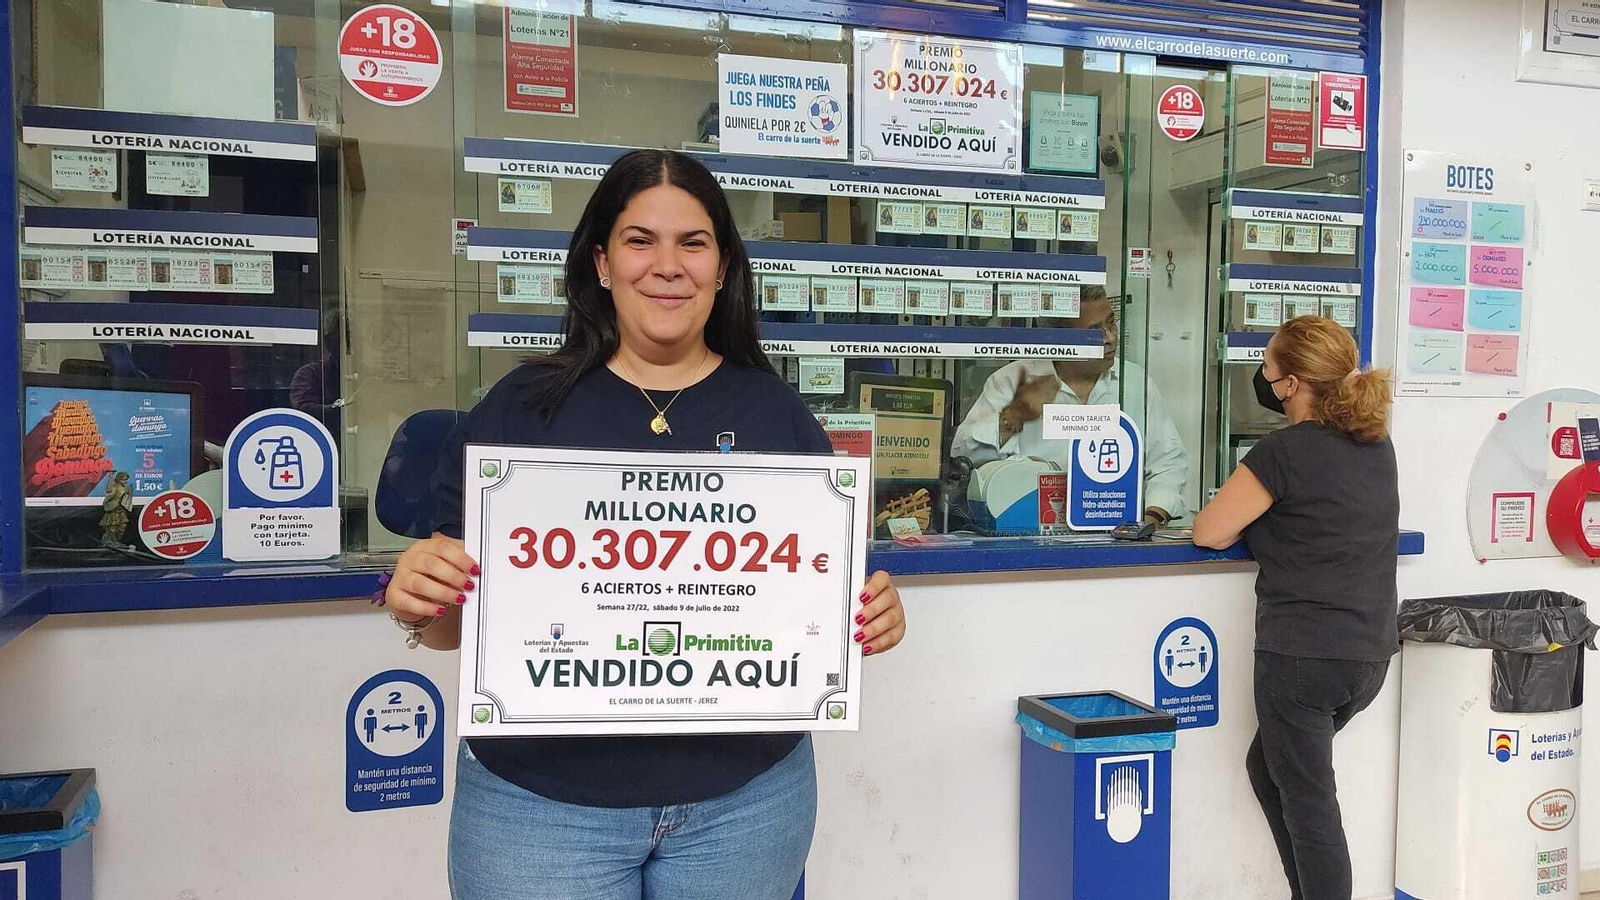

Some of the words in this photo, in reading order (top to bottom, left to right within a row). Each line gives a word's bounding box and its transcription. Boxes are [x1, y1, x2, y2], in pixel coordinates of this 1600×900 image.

[361, 16, 416, 49] +18
[549, 29, 569, 37] Nº21
[919, 45, 963, 58] PREMIO
[1096, 33, 1289, 65] www.elcarrodelasuerte.com
[511, 52, 534, 61] Alarma
[535, 55, 570, 65] Conectada
[531, 62, 564, 71] Seguridad
[904, 58, 977, 74] MILLONARIO
[725, 71, 756, 86] JUEGA
[759, 74, 802, 89] NUESTRA
[805, 76, 830, 91] PEÑA
[872, 69, 996, 99] 30.307.024
[1000, 90, 1007, 100] €
[729, 90, 752, 106] LOS
[756, 92, 796, 109] FINDES
[909, 98, 937, 106] ACIERTOS
[1168, 91, 1193, 109] +18
[725, 116, 767, 130] QUINIELA
[771, 119, 790, 131] POR
[794, 120, 806, 132] 2€
[918, 123, 928, 132] La
[947, 126, 984, 135] Primitiva
[92, 134, 163, 148] LOTERÍA
[169, 140, 253, 153] NACIONAL
[784, 134, 791, 142] de
[801, 136, 820, 144] suerte
[881, 132, 951, 149] VENDIDO
[957, 136, 996, 153] AQUÍ
[500, 162, 559, 174] LOTERÍA
[730, 176, 794, 189] NACIONAL
[1446, 164, 1493, 190] BOTES
[830, 182, 880, 194] LOTERÍA
[883, 186, 942, 197] NACIONAL
[975, 191, 1022, 201] LOTERÍA
[1025, 194, 1079, 205] NACIONAL
[1252, 208, 1293, 219] LOTERÍA
[1295, 212, 1343, 222] NACIONAL
[93, 232, 164, 245] LOTERÍA
[170, 235, 254, 247] NACIONAL
[502, 250, 562, 261] LOTERÍA
[831, 264, 881, 275] LOTERÍA
[885, 267, 943, 277] NACIONAL
[976, 270, 1023, 280] LOTERÍA
[1026, 272, 1080, 282] NACIONAL
[1249, 281, 1290, 291] LOTERÍA
[1293, 283, 1340, 293] NACIONAL
[92, 326, 162, 337] LOTERÍA
[169, 328, 254, 339] NACIONAL
[502, 335, 561, 345] LOTERÍA
[830, 343, 880, 353] LOTERÍA
[883, 345, 941, 354] NACIONAL
[974, 346, 1021, 355] LOTERÍA
[1023, 347, 1078, 356] NACIONAL
[876, 435, 930, 447] IENVENIDO
[143, 453, 154, 467] 5
[621, 470, 724, 493] PREMIO
[1082, 490, 1098, 498] Utiliza
[154, 497, 196, 520] +18
[584, 500, 756, 524] MILLONARIO
[274, 531, 310, 539] tarjeta.
[508, 526, 802, 573] 30.307.024
[811, 553, 829, 574] €
[581, 582, 589, 594] 6
[593, 582, 662, 594] ACIERTOS
[678, 583, 756, 596] REINTEGRO
[626, 603, 649, 611] 27/22,
[652, 603, 678, 611] sábado
[695, 605, 711, 613] julio
[616, 634, 639, 650] La
[684, 633, 772, 651] Primitiva
[1181, 635, 1190, 645] 2
[525, 659, 693, 687] VENDIDO
[706, 652, 800, 688] AQUÍ
[388, 691, 402, 705] 2
[1162, 696, 1179, 705] Mantén
[1190, 693, 1211, 702] distancia
[1180, 715, 1197, 723] metros
[1531, 732, 1566, 743] Loterías
[1567, 733, 1571, 742] y
[1530, 750, 1545, 761] del
[1548, 748, 1574, 760] Estado.
[358, 767, 384, 779] Mantén
[386, 769, 399, 777] una
[400, 763, 432, 775] distancia
[353, 783, 363, 792] de
[364, 779, 399, 792] seguridad
[400, 778, 409, 787] de
[410, 776, 436, 787] mínimo
[380, 793, 384, 801] 2
[386, 791, 410, 801] metros
